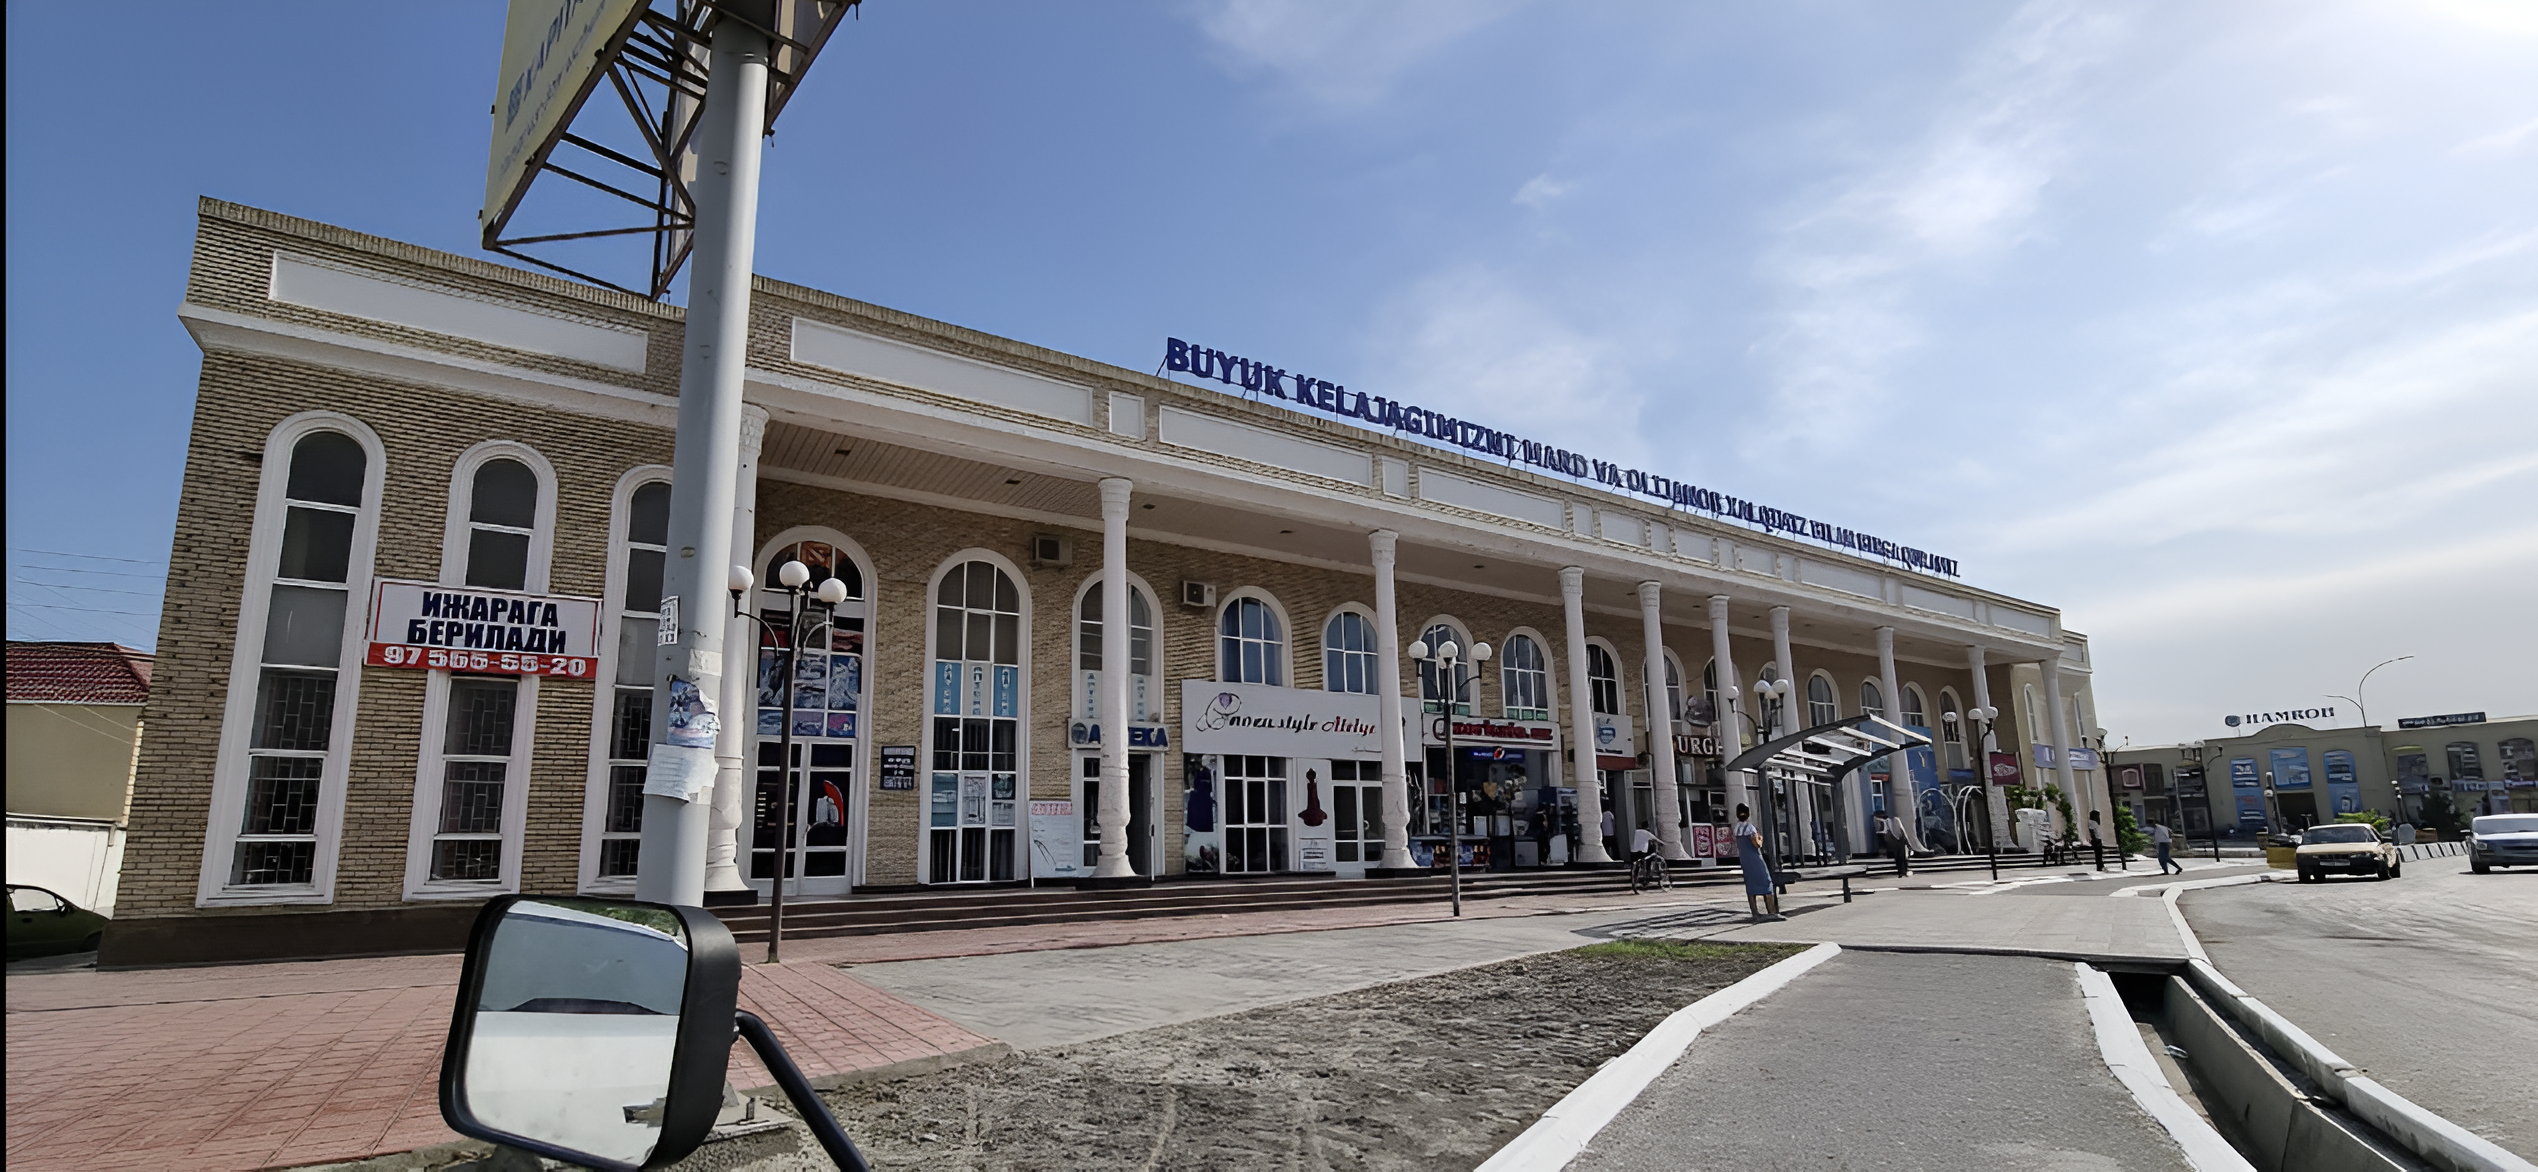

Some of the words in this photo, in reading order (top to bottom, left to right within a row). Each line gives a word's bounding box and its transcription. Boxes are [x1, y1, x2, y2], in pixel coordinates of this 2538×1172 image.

[1166, 336, 1288, 400] BUYUK
[1592, 458, 1624, 488] VA
[421, 591, 559, 628] ИЖАРАГА
[407, 618, 567, 654] БЕРИЛАДИ
[383, 645, 422, 665] 97
